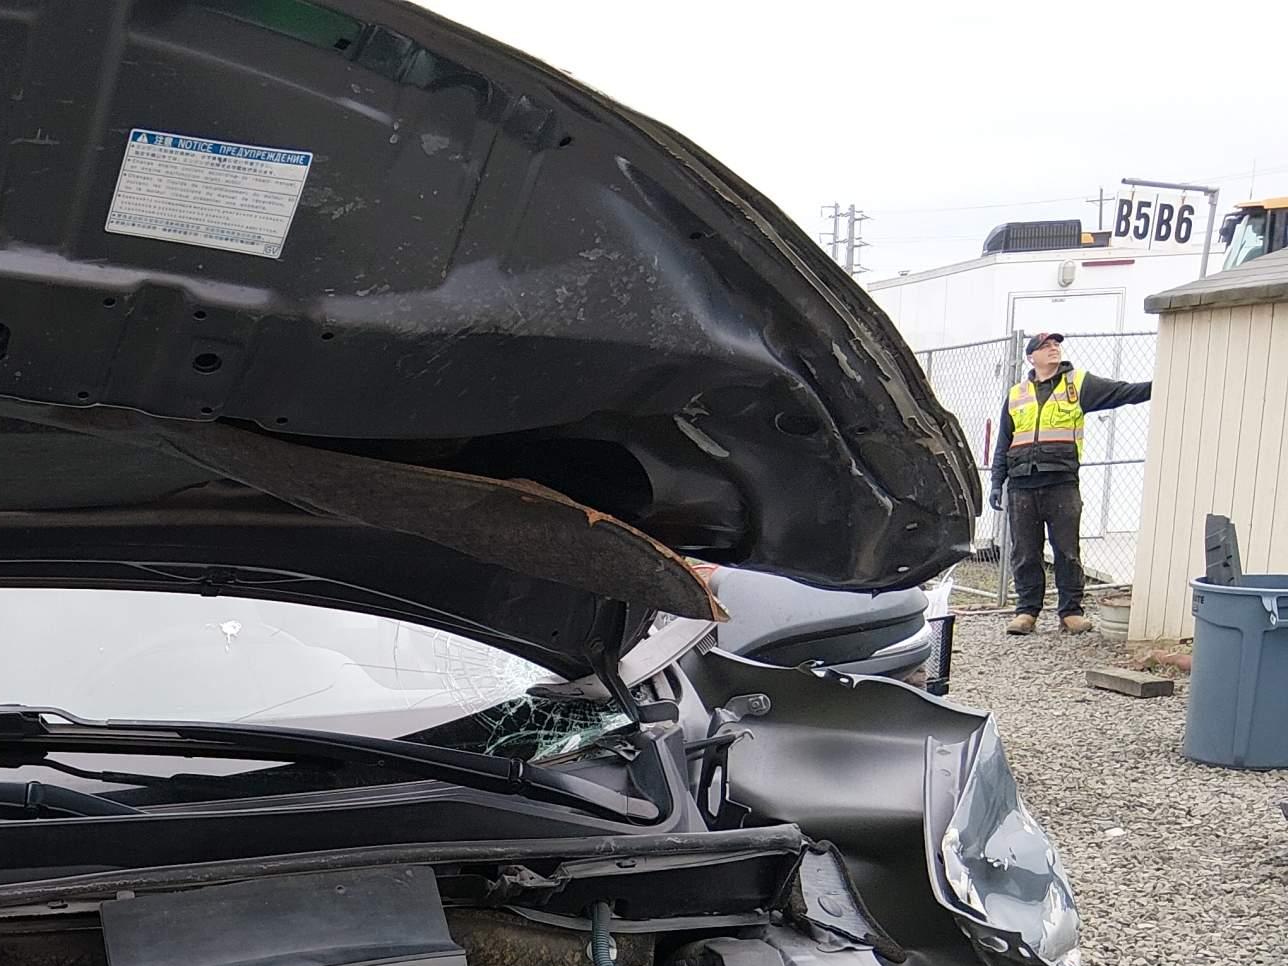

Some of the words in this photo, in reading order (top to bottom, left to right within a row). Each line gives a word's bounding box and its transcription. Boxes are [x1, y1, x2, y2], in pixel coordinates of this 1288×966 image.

[177, 139, 214, 153] NOTICE
[218, 145, 307, 165] ПРЕДУПРЕЖДЕНИЕ
[1114, 198, 1152, 240] B5
[1154, 203, 1195, 244] B6
[265, 246, 279, 255] GV
